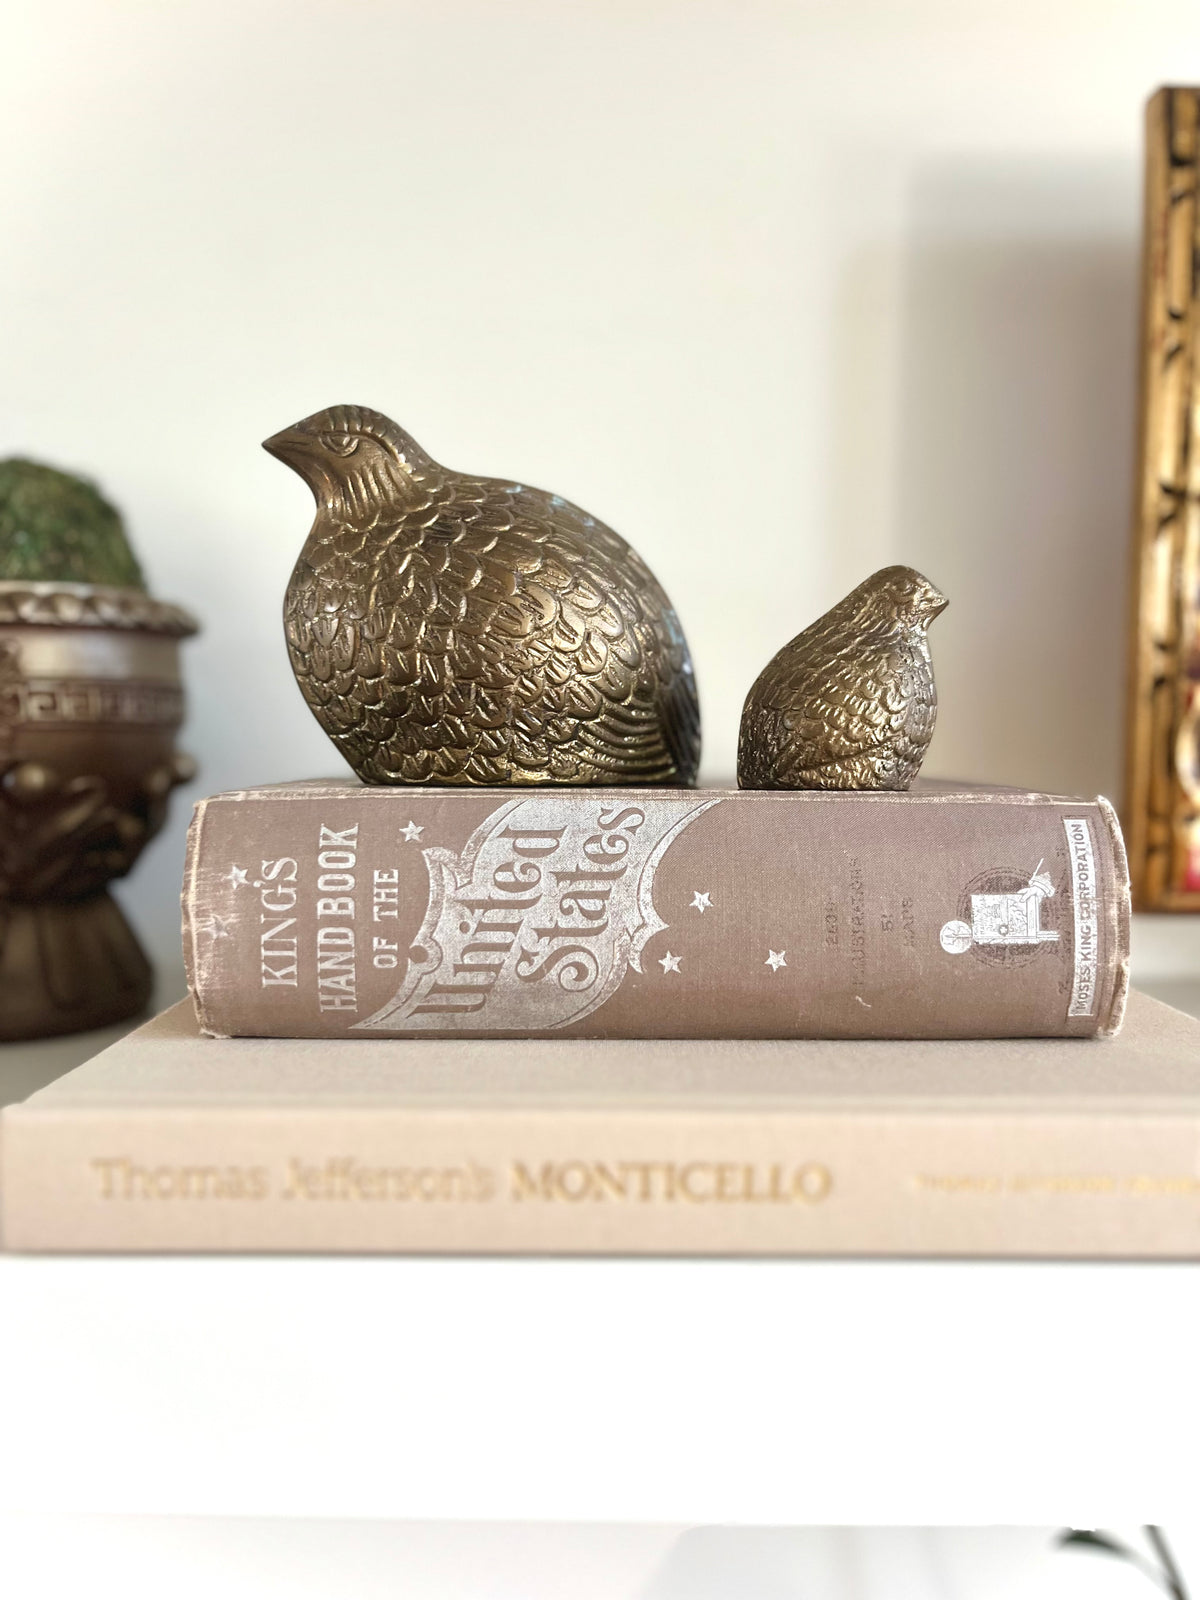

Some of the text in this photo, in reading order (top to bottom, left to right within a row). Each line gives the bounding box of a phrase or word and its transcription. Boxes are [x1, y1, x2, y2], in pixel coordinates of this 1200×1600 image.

[253, 857, 298, 988] KING'S
[373, 868, 399, 969] OF THE
[405, 825, 568, 1019] United
[515, 806, 645, 992] States
[1071, 823, 1093, 1011] MOSES KING CORPORATION
[90, 1156, 269, 1200] Thomas
[511, 1159, 834, 1204] MONTICELLO
